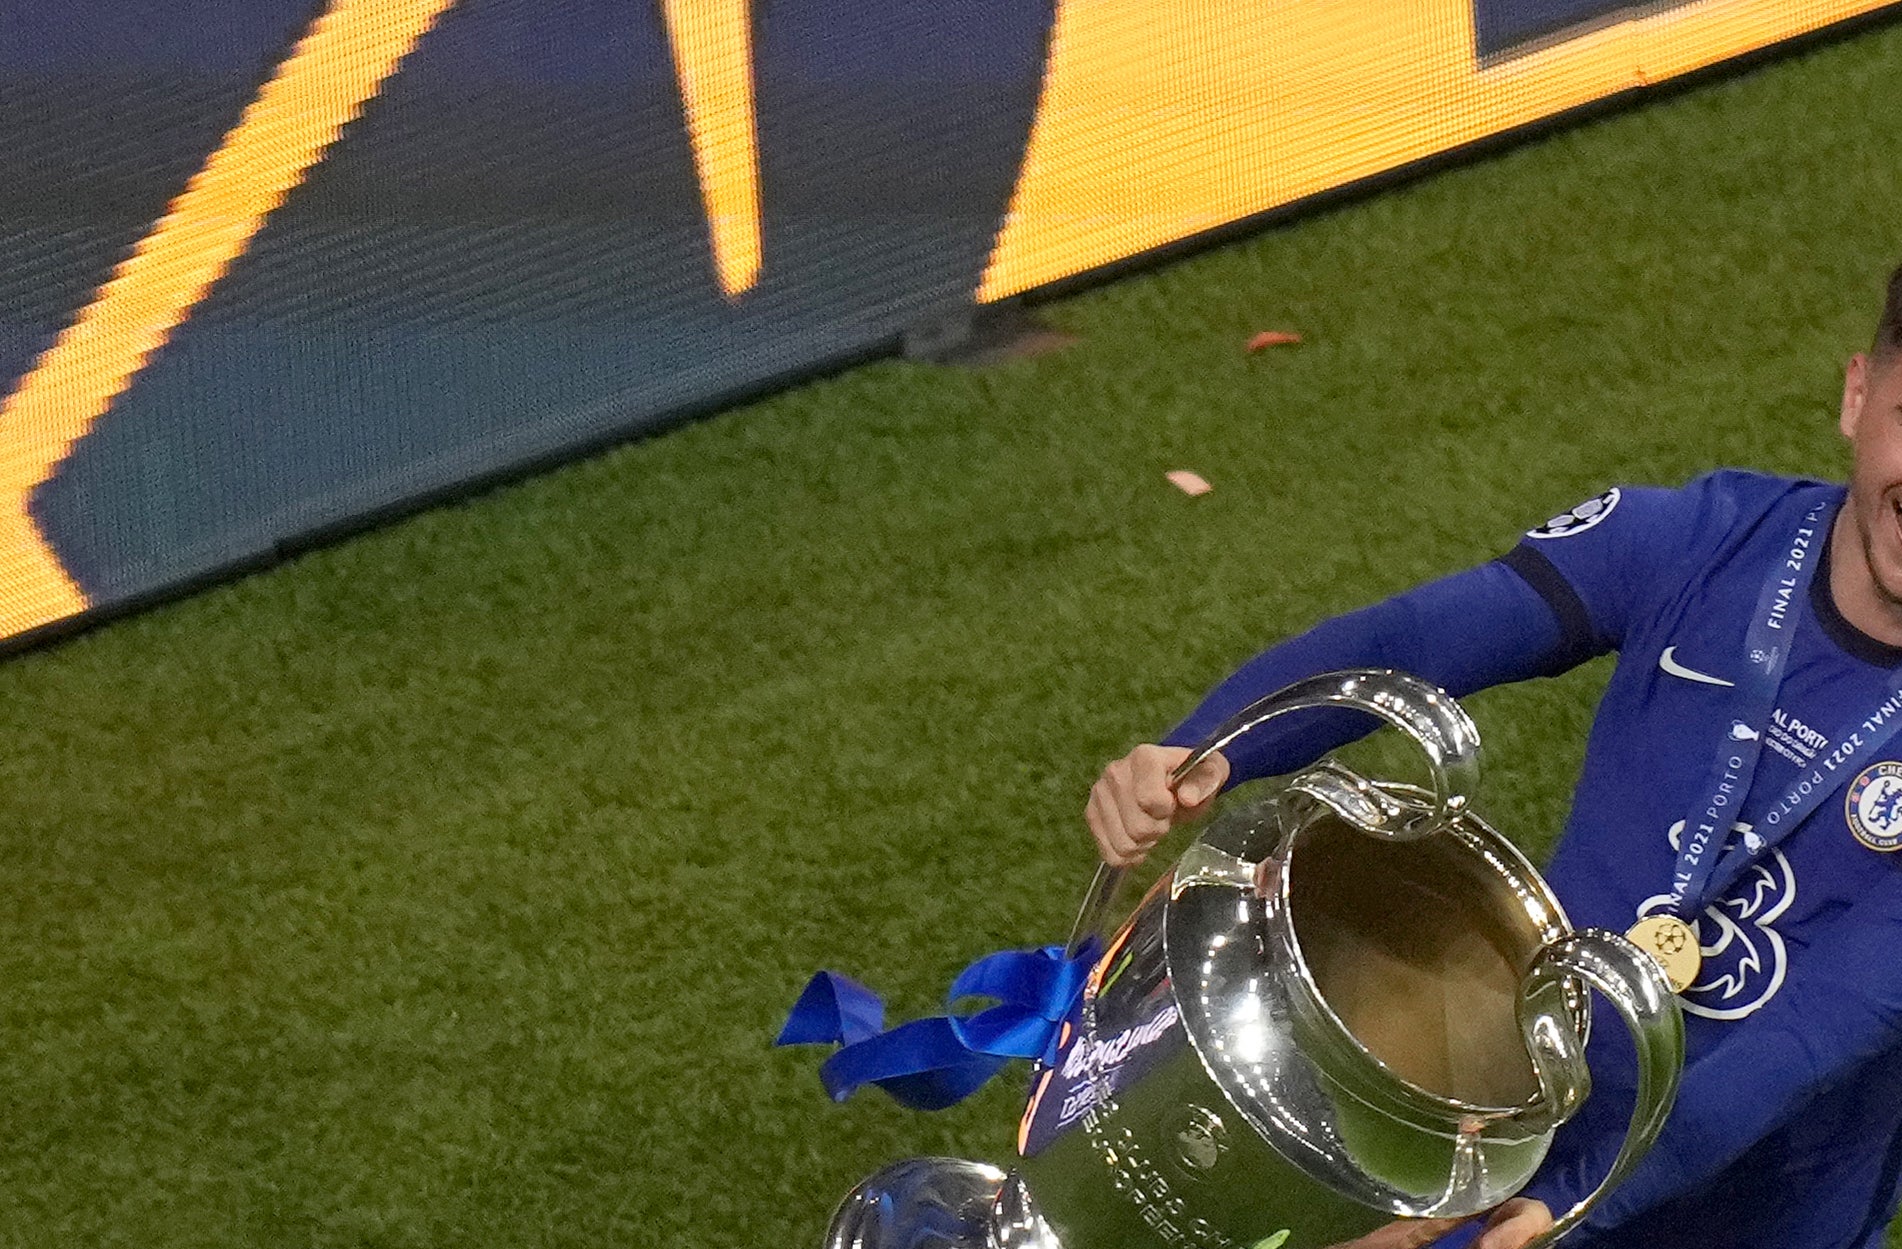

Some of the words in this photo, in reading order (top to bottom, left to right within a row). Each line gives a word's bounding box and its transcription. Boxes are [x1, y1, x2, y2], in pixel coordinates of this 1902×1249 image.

[1767, 578, 1796, 630] FINAL
[1786, 528, 1814, 571] 2021
[1823, 733, 1864, 771] 2021
[1667, 871, 1692, 913] INAL
[1684, 823, 1714, 866] 2021
[1706, 755, 1743, 819] PORTO
[1766, 770, 1824, 825] PORTO
